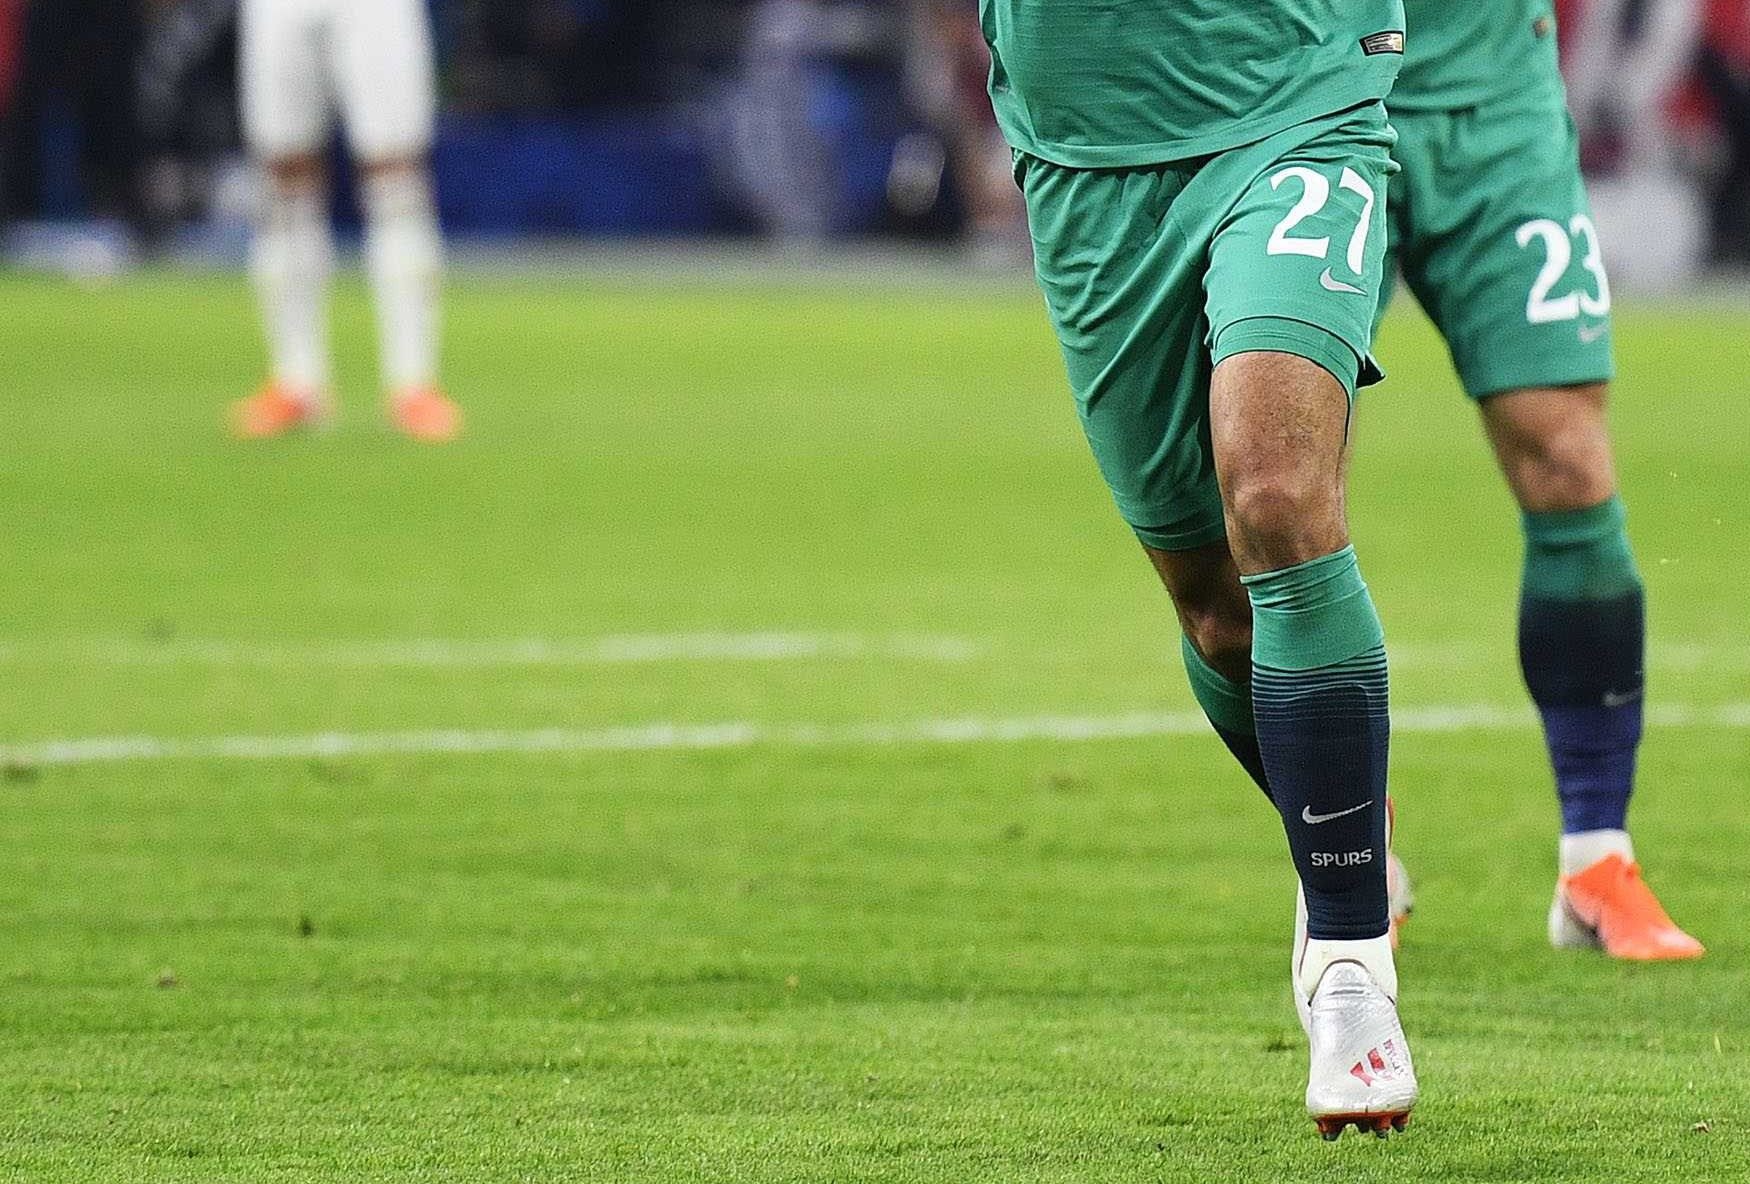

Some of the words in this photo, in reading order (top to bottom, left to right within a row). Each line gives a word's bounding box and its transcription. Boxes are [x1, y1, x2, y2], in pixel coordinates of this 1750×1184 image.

[1266, 166, 1376, 275] 27
[1515, 213, 1611, 324] 23
[1311, 848, 1373, 867] SPURS
